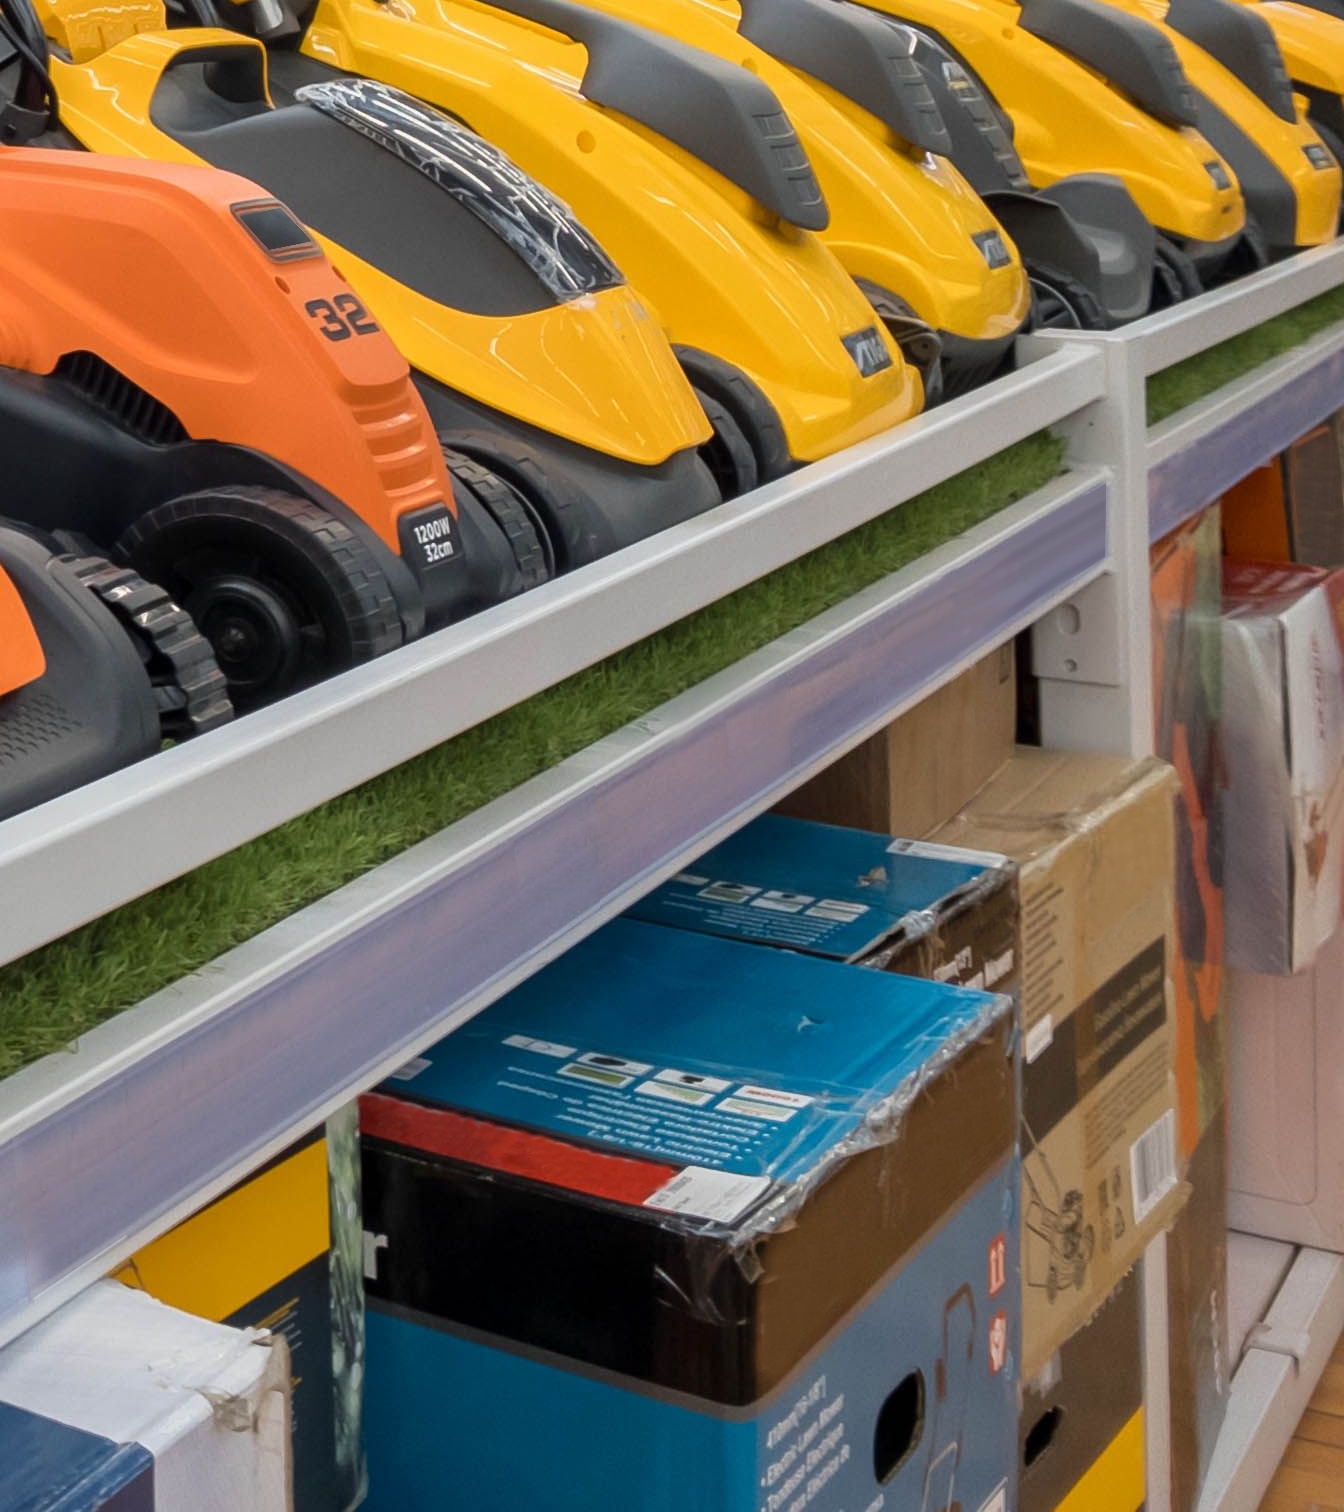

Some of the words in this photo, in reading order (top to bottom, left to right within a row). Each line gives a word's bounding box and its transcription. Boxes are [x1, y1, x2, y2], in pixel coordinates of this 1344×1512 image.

[305, 293, 380, 341] 32
[414, 516, 450, 544] 1200W
[423, 541, 454, 563] 32cm
